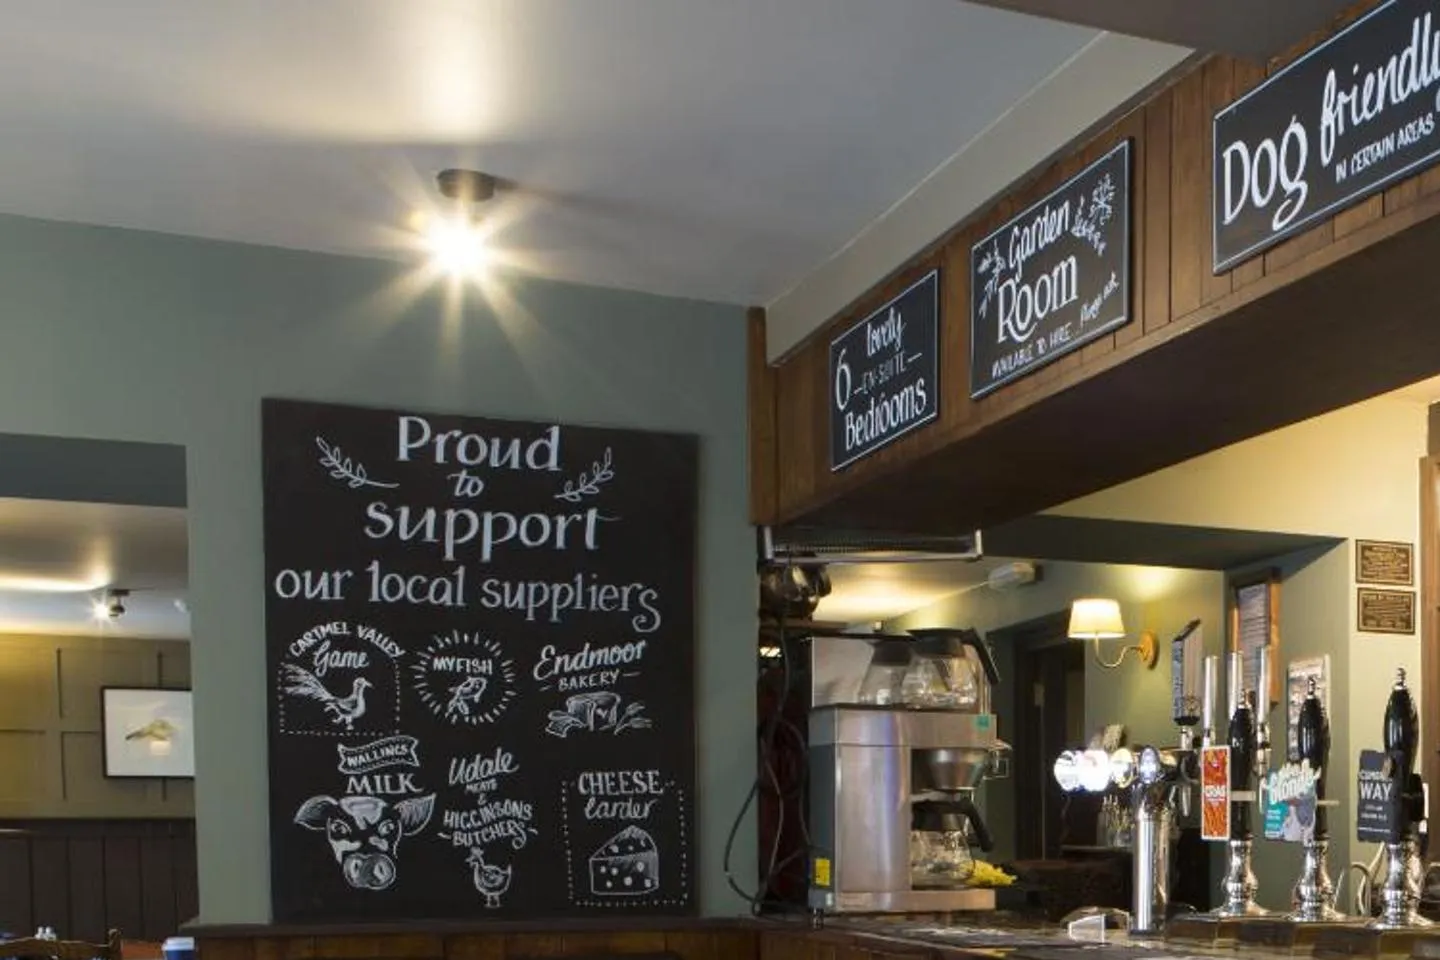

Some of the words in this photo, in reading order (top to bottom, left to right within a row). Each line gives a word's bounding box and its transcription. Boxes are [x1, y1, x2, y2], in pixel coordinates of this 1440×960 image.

[1335, 159, 1347, 184] IN
[1351, 132, 1395, 175] CERTAIN
[1397, 112, 1435, 149] AREAS
[1222, 115, 1307, 231] Dog
[1010, 200, 1069, 283] Garden
[998, 255, 1079, 343] Room
[835, 348, 851, 411] 6
[845, 377, 927, 451] Bedrooms
[397, 416, 563, 472] Proud
[448, 469, 484, 498] to
[364, 501, 621, 563] support
[275, 568, 353, 601] our
[366, 561, 467, 607] local
[481, 573, 661, 633] suppliers
[290, 622, 351, 656] CARTMEL
[357, 625, 407, 658] VALLEY
[313, 640, 370, 678] Game
[533, 640, 648, 681] Endmoor
[558, 670, 621, 692] BAKERY
[346, 773, 424, 794] MILK
[449, 747, 519, 785] Udale
[578, 771, 664, 796] CHEESE
[584, 797, 657, 820] larder
[1360, 782, 1393, 801] WAY
[453, 820, 527, 849] BUTCHERS
